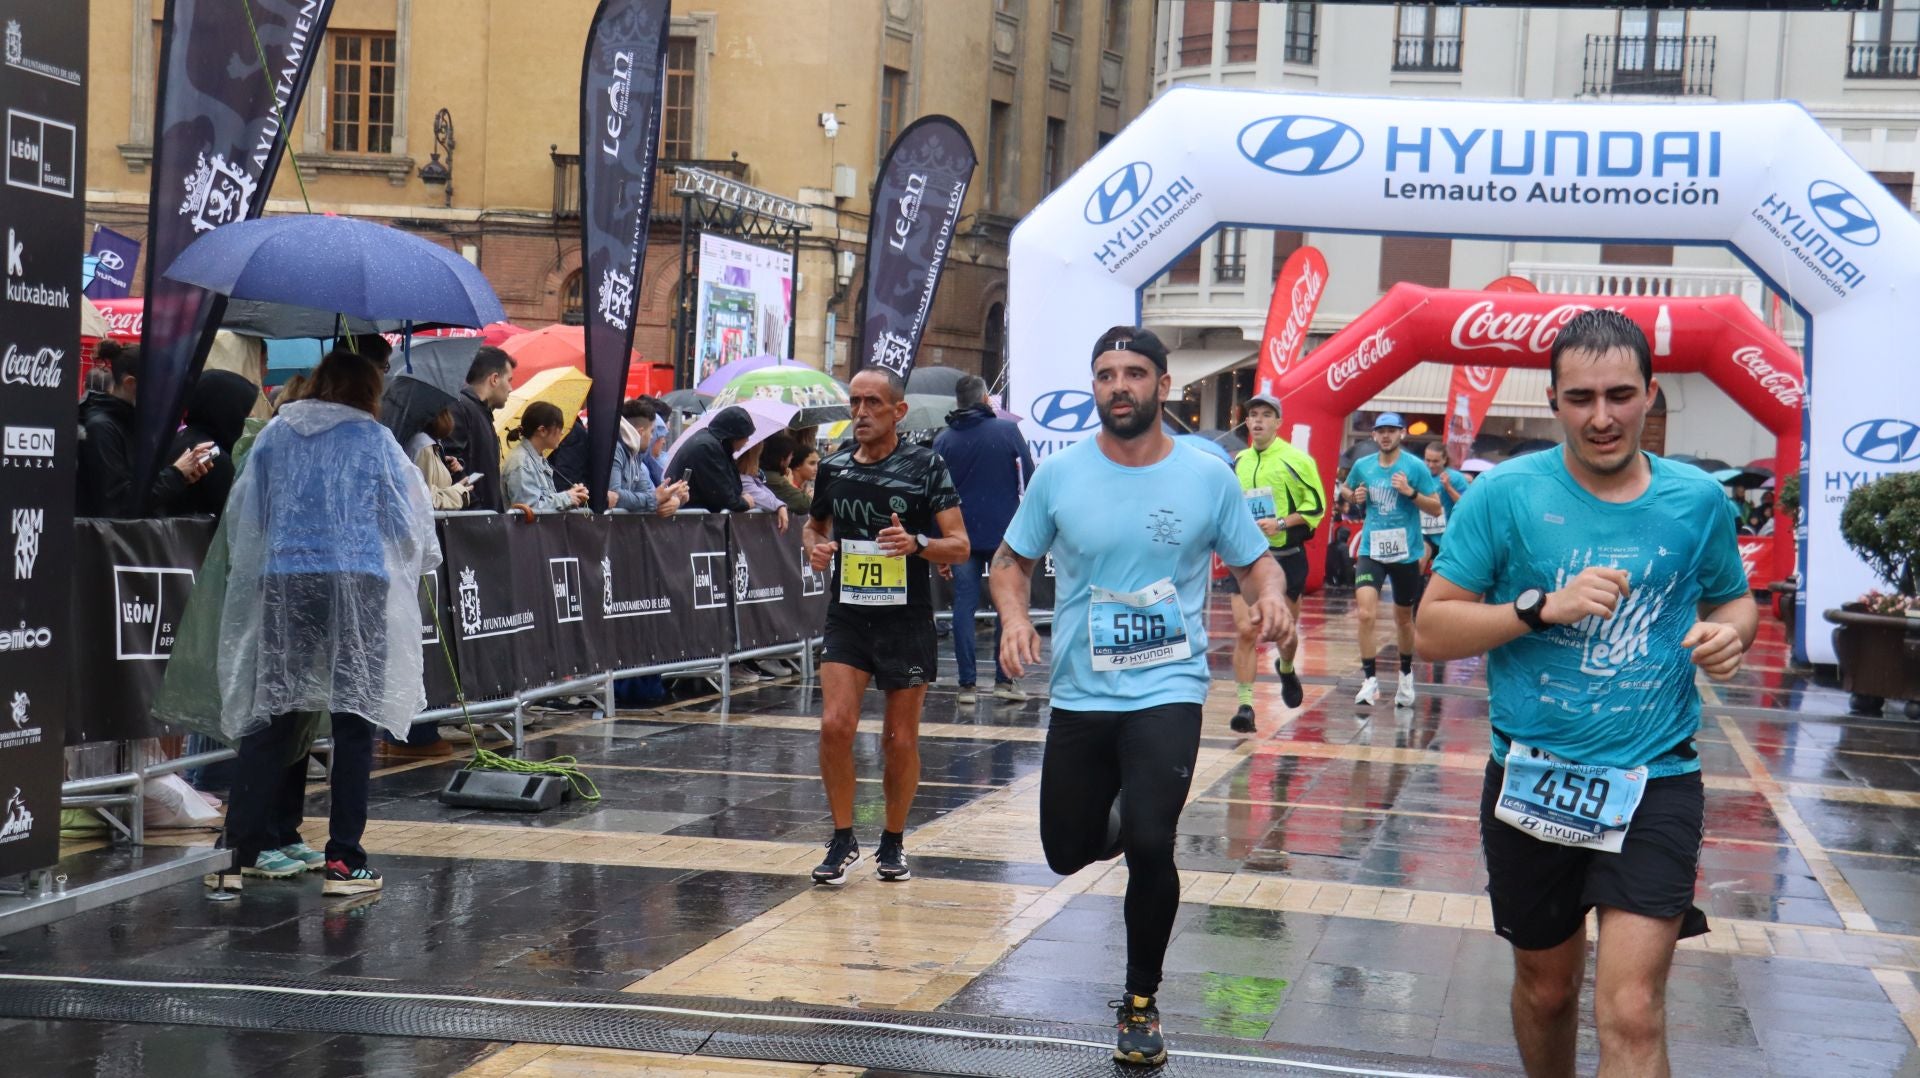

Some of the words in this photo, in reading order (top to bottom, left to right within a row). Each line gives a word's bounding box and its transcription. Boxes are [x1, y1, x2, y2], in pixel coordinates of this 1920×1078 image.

[11, 137, 39, 162] LEÓN
[1385, 126, 1721, 177] HYUNDAI
[44, 163, 51, 172] ES
[44, 174, 66, 187] DEPORTE
[1384, 178, 1517, 203] Lemauto
[1526, 181, 1720, 206] Automoción
[1094, 176, 1194, 266] HYUNDAI
[1108, 233, 1148, 275] Lemauto
[1148, 190, 1203, 241] Automoción
[1751, 208, 1792, 248] Lemauto
[1790, 246, 1848, 299] Automoción
[1761, 192, 1867, 290] HYUNDAI
[910, 239, 946, 340] AYUNTAMIENTO
[940, 218, 952, 237] DE
[946, 181, 963, 216] LEÓN
[6, 278, 70, 309] kutxabank
[1270, 257, 1322, 376] Coca-Cola
[2, 344, 65, 389] Coca-Cola
[1327, 326, 1396, 392] Coca-Cola
[1731, 346, 1804, 408] Coca-Cola
[7, 431, 53, 450] LEON
[3, 458, 55, 468] PLAZA
[1378, 541, 1399, 554] 984
[857, 563, 882, 586] 79
[123, 596, 155, 623] LEÓN
[612, 600, 651, 612] AYUNTAMIENTO
[162, 623, 171, 632] ES
[1113, 613, 1166, 645] 596
[1129, 647, 1174, 663] HYUNDAI
[1533, 769, 1610, 820] 459
